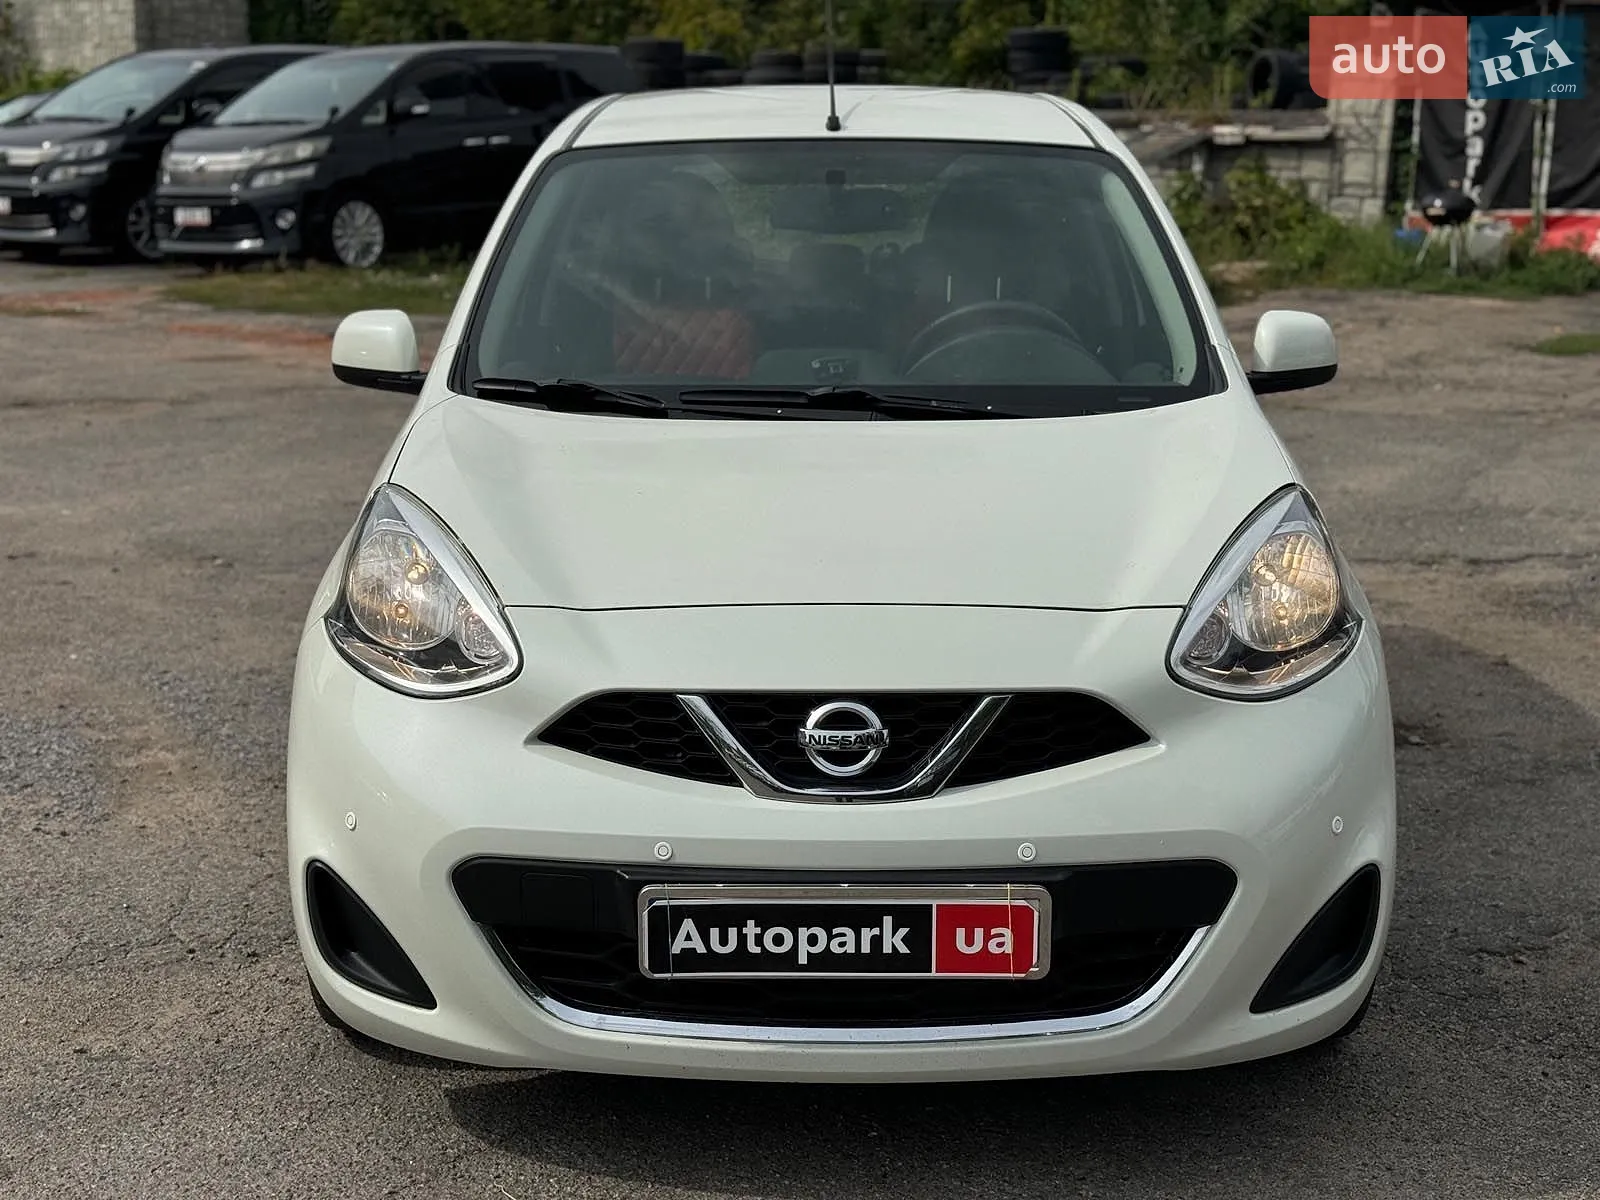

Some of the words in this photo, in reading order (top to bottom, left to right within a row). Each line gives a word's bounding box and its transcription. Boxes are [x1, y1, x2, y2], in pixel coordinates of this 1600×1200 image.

[808, 732, 884, 747] NISSAN
[671, 915, 911, 964] Autopark
[954, 926, 1014, 955] ua
